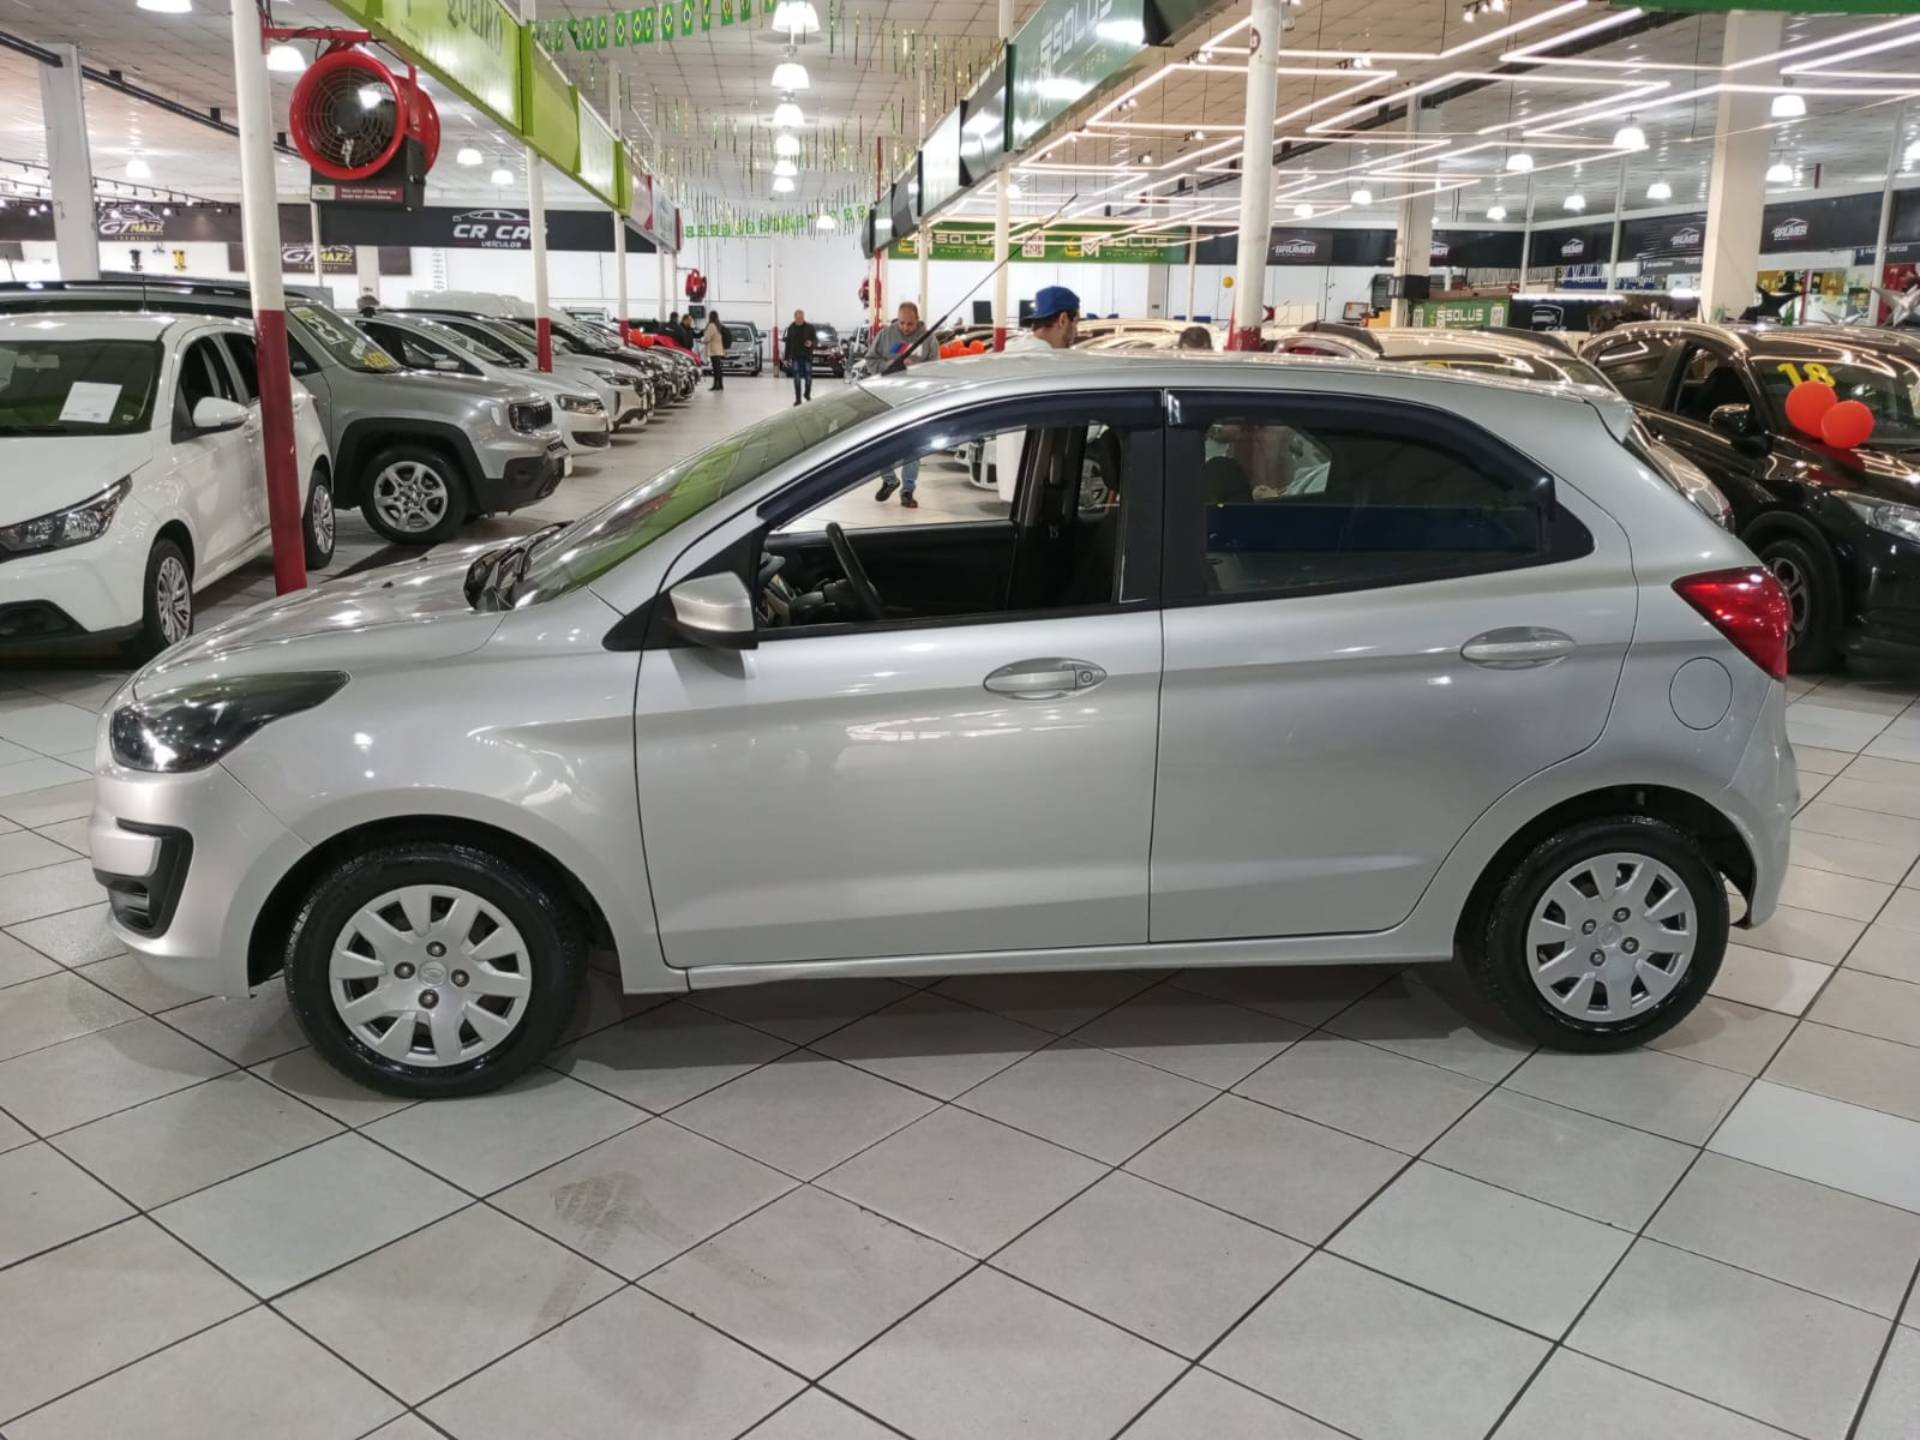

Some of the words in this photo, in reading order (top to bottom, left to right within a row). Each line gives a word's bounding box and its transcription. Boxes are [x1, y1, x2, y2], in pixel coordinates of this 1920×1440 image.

[453, 224, 488, 239] CR
[495, 225, 548, 240] CA
[1776, 362, 1835, 387] 18
